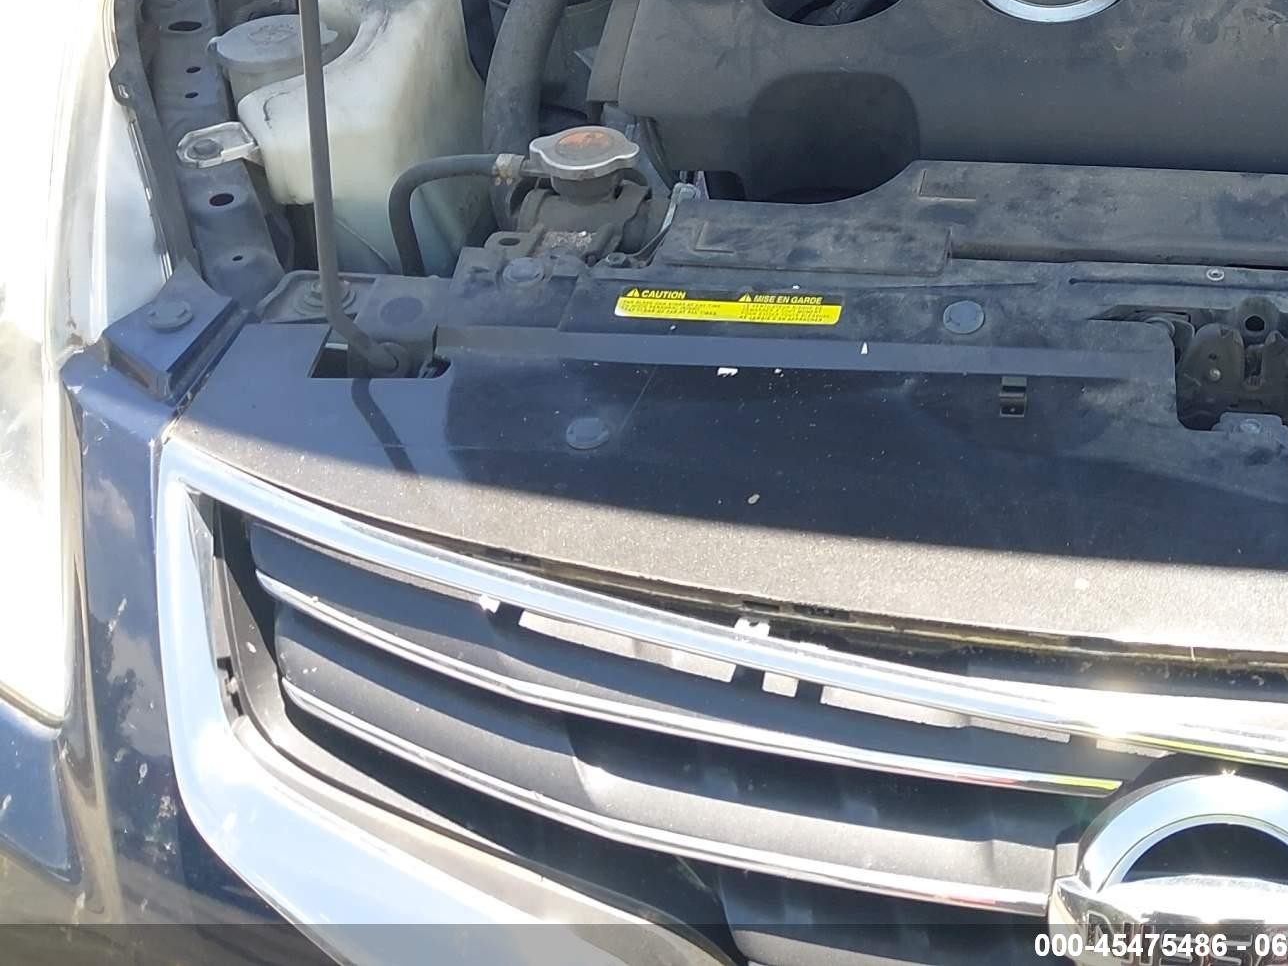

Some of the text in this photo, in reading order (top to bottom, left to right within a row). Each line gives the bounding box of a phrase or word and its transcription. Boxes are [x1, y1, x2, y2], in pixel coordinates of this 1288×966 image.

[641, 289, 686, 300] CAUTION
[753, 294, 823, 305] MISE EN GARDE
